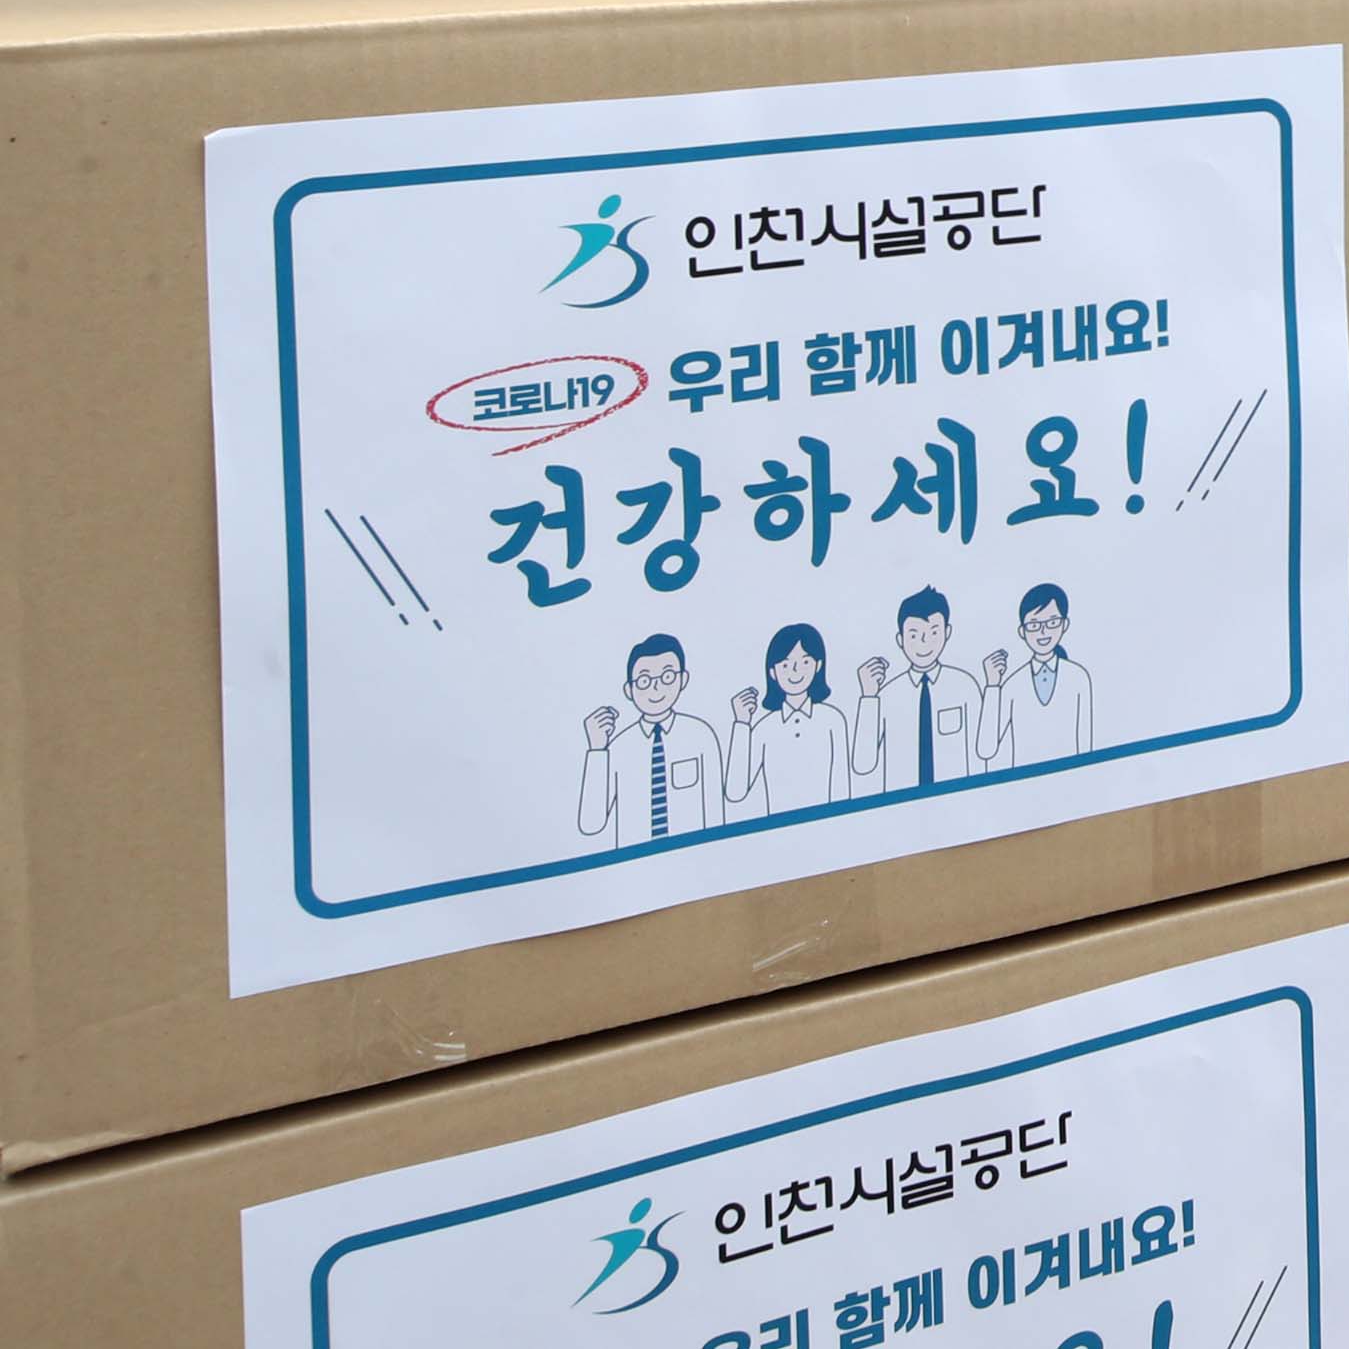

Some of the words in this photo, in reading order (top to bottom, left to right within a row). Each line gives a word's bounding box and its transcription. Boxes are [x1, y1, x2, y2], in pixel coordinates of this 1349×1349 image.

[684, 184, 1047, 279] 인천시설공단
[472, 373, 615, 423] 코로나19
[668, 341, 781, 413] 우리
[803, 325, 918, 398] 함께
[939, 299, 1170, 376] 이겨내요!
[487, 398, 1149, 608] 건강하세요!
[713, 1110, 1073, 1265] 인천시설공단
[833, 1267, 944, 1348] 함께
[967, 1199, 1196, 1310] 이겨내요!
